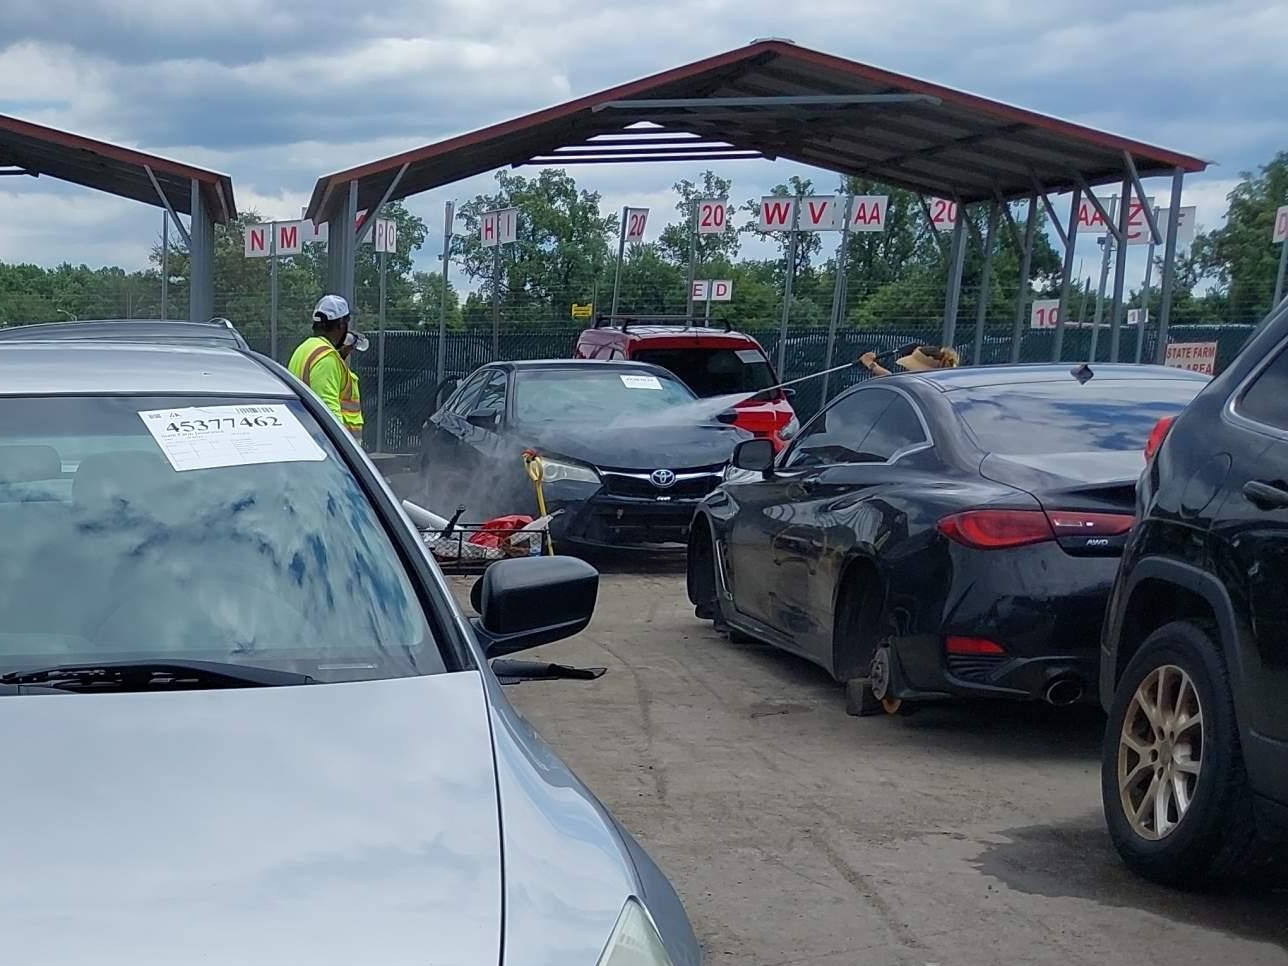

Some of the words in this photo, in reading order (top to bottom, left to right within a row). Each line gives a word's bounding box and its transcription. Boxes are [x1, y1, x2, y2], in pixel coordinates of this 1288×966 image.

[701, 204, 724, 227] 20
[764, 202, 791, 225] W
[809, 201, 827, 225] V
[854, 202, 881, 225] AA
[934, 200, 959, 223] 20
[485, 217, 494, 240] H
[629, 214, 646, 236] 20
[251, 229, 264, 251] N
[280, 226, 297, 249] M
[693, 283, 703, 297] E
[716, 283, 727, 297] D
[1036, 307, 1059, 326] 10
[1167, 348, 1191, 359] STATE
[1193, 346, 1216, 358] FARM
[166, 416, 282, 433] 45377462
